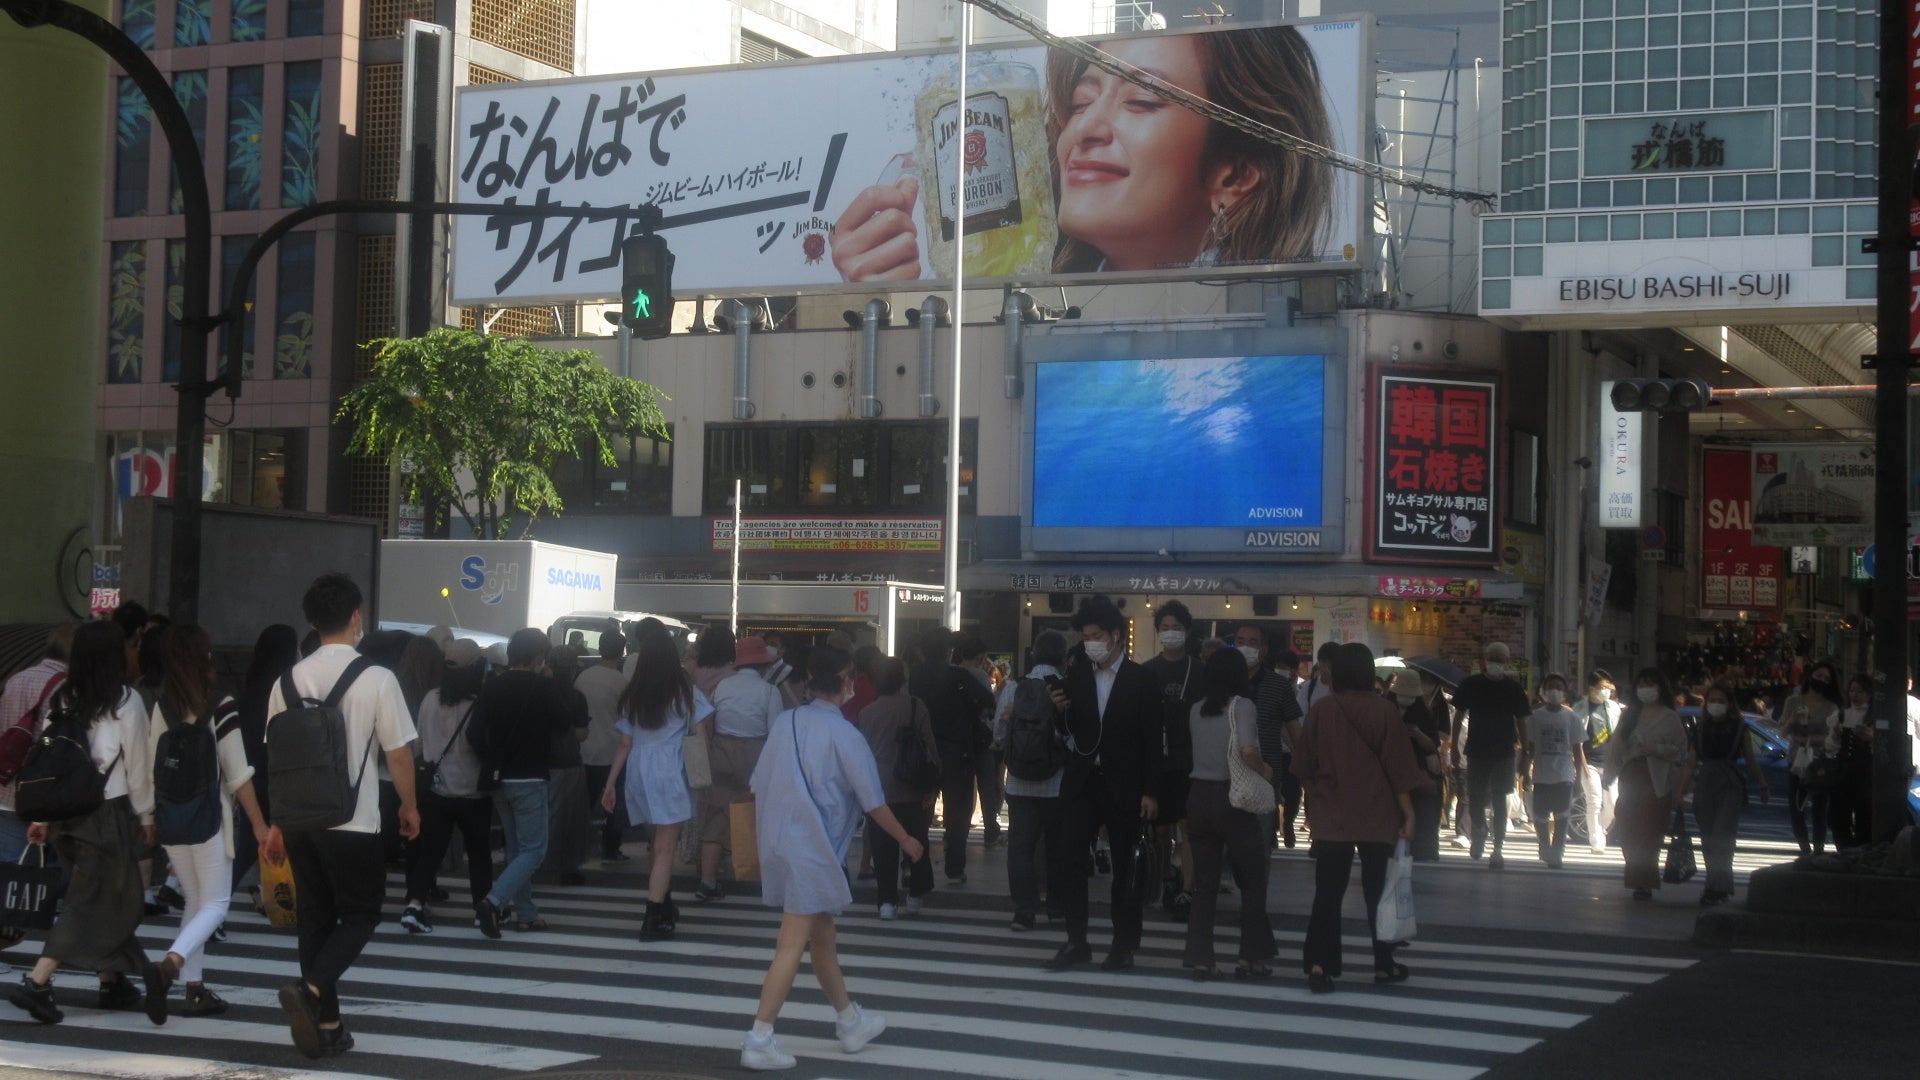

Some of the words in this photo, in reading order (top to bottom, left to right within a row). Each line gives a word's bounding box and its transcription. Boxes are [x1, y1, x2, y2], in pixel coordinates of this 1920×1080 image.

[964, 108, 1005, 134] BEAM
[1650, 120, 1707, 141] なんば
[460, 76, 687, 199] なんばで
[1631, 137, 1726, 171] 戎橋筋
[645, 156, 803, 207] ジムビームハイボール!
[950, 180, 1003, 206] BURBON
[792, 221, 810, 240] JIM
[811, 216, 836, 236] BEAM
[1559, 278, 1636, 301] EBISU
[1390, 385, 1488, 448] 韓国
[1615, 417, 1627, 476] OKURA
[1388, 448, 1488, 493] 石焼き
[1608, 492, 1633, 505] 高価
[1608, 506, 1633, 519] 買取
[744, 522, 781, 532] agencies
[800, 520, 842, 529] welcomed
[844, 521, 854, 529] to
[855, 520, 880, 529] make
[881, 521, 888, 529] a
[889, 521, 939, 530] reservation
[547, 567, 602, 592] SAGAWA
[1711, 561, 1725, 575] 1F
[1735, 562, 1749, 575] 2F
[1759, 563, 1774, 576] 3F
[1012, 574, 1041, 590] 韓国
[1053, 573, 1095, 590] 石焼き
[853, 590, 869, 613] 15
[6, 880, 47, 913] GAP
